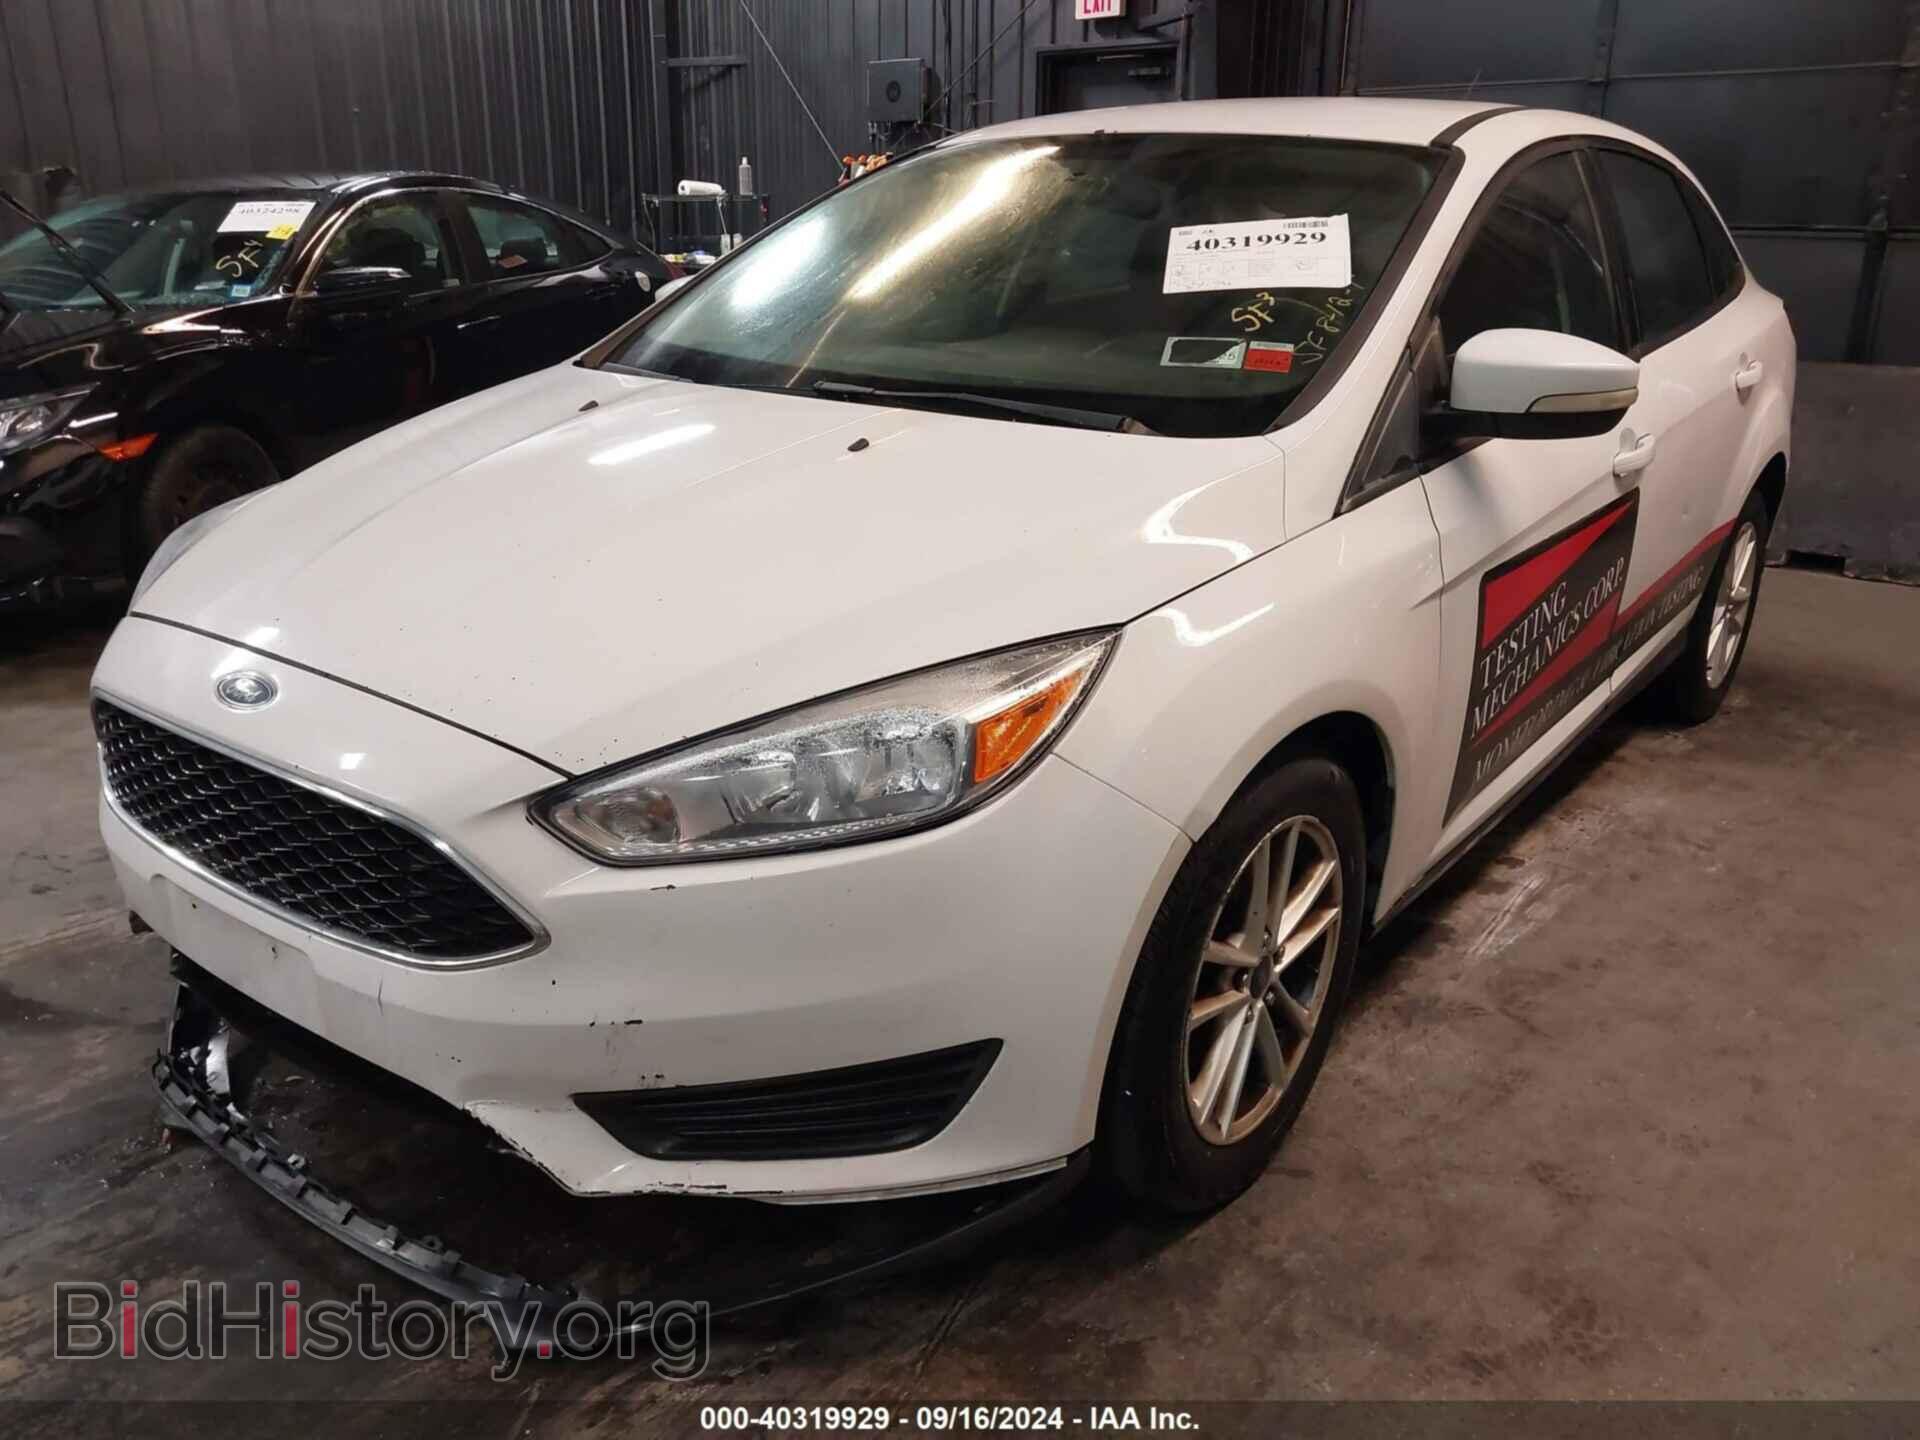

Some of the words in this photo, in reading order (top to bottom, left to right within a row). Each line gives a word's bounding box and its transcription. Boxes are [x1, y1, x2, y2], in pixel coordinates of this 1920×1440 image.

[1186, 231, 1327, 252] 40319929
[1471, 601, 1582, 739] MECHANICS
[1584, 556, 1625, 618] CORP.
[1480, 582, 1568, 690] TESTING
